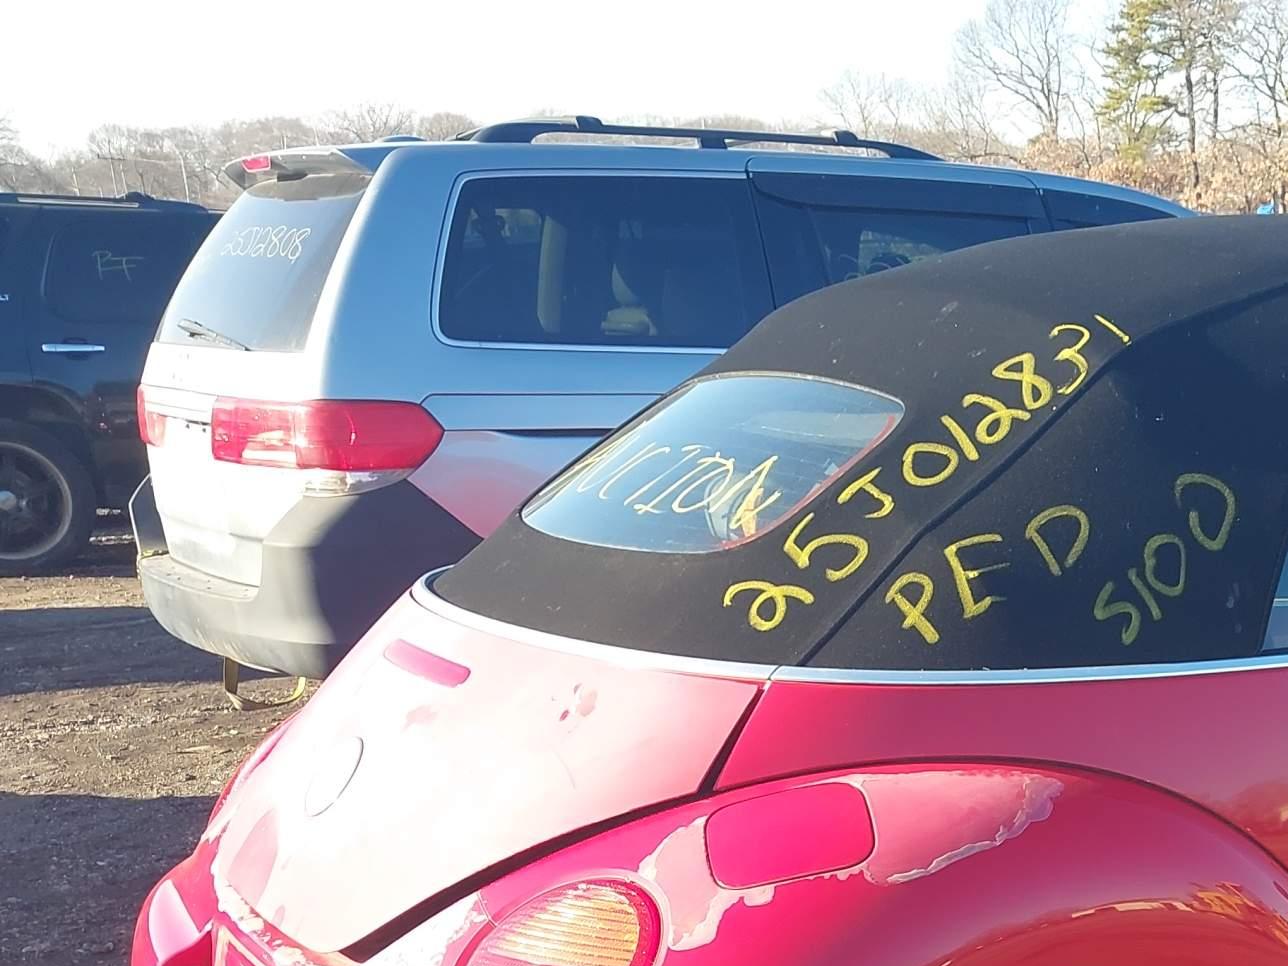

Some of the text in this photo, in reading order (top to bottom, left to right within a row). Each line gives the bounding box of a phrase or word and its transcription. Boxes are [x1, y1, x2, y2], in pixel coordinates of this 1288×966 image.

[722, 314, 1132, 632] 25J012831
[885, 472, 1237, 646] PED S100
